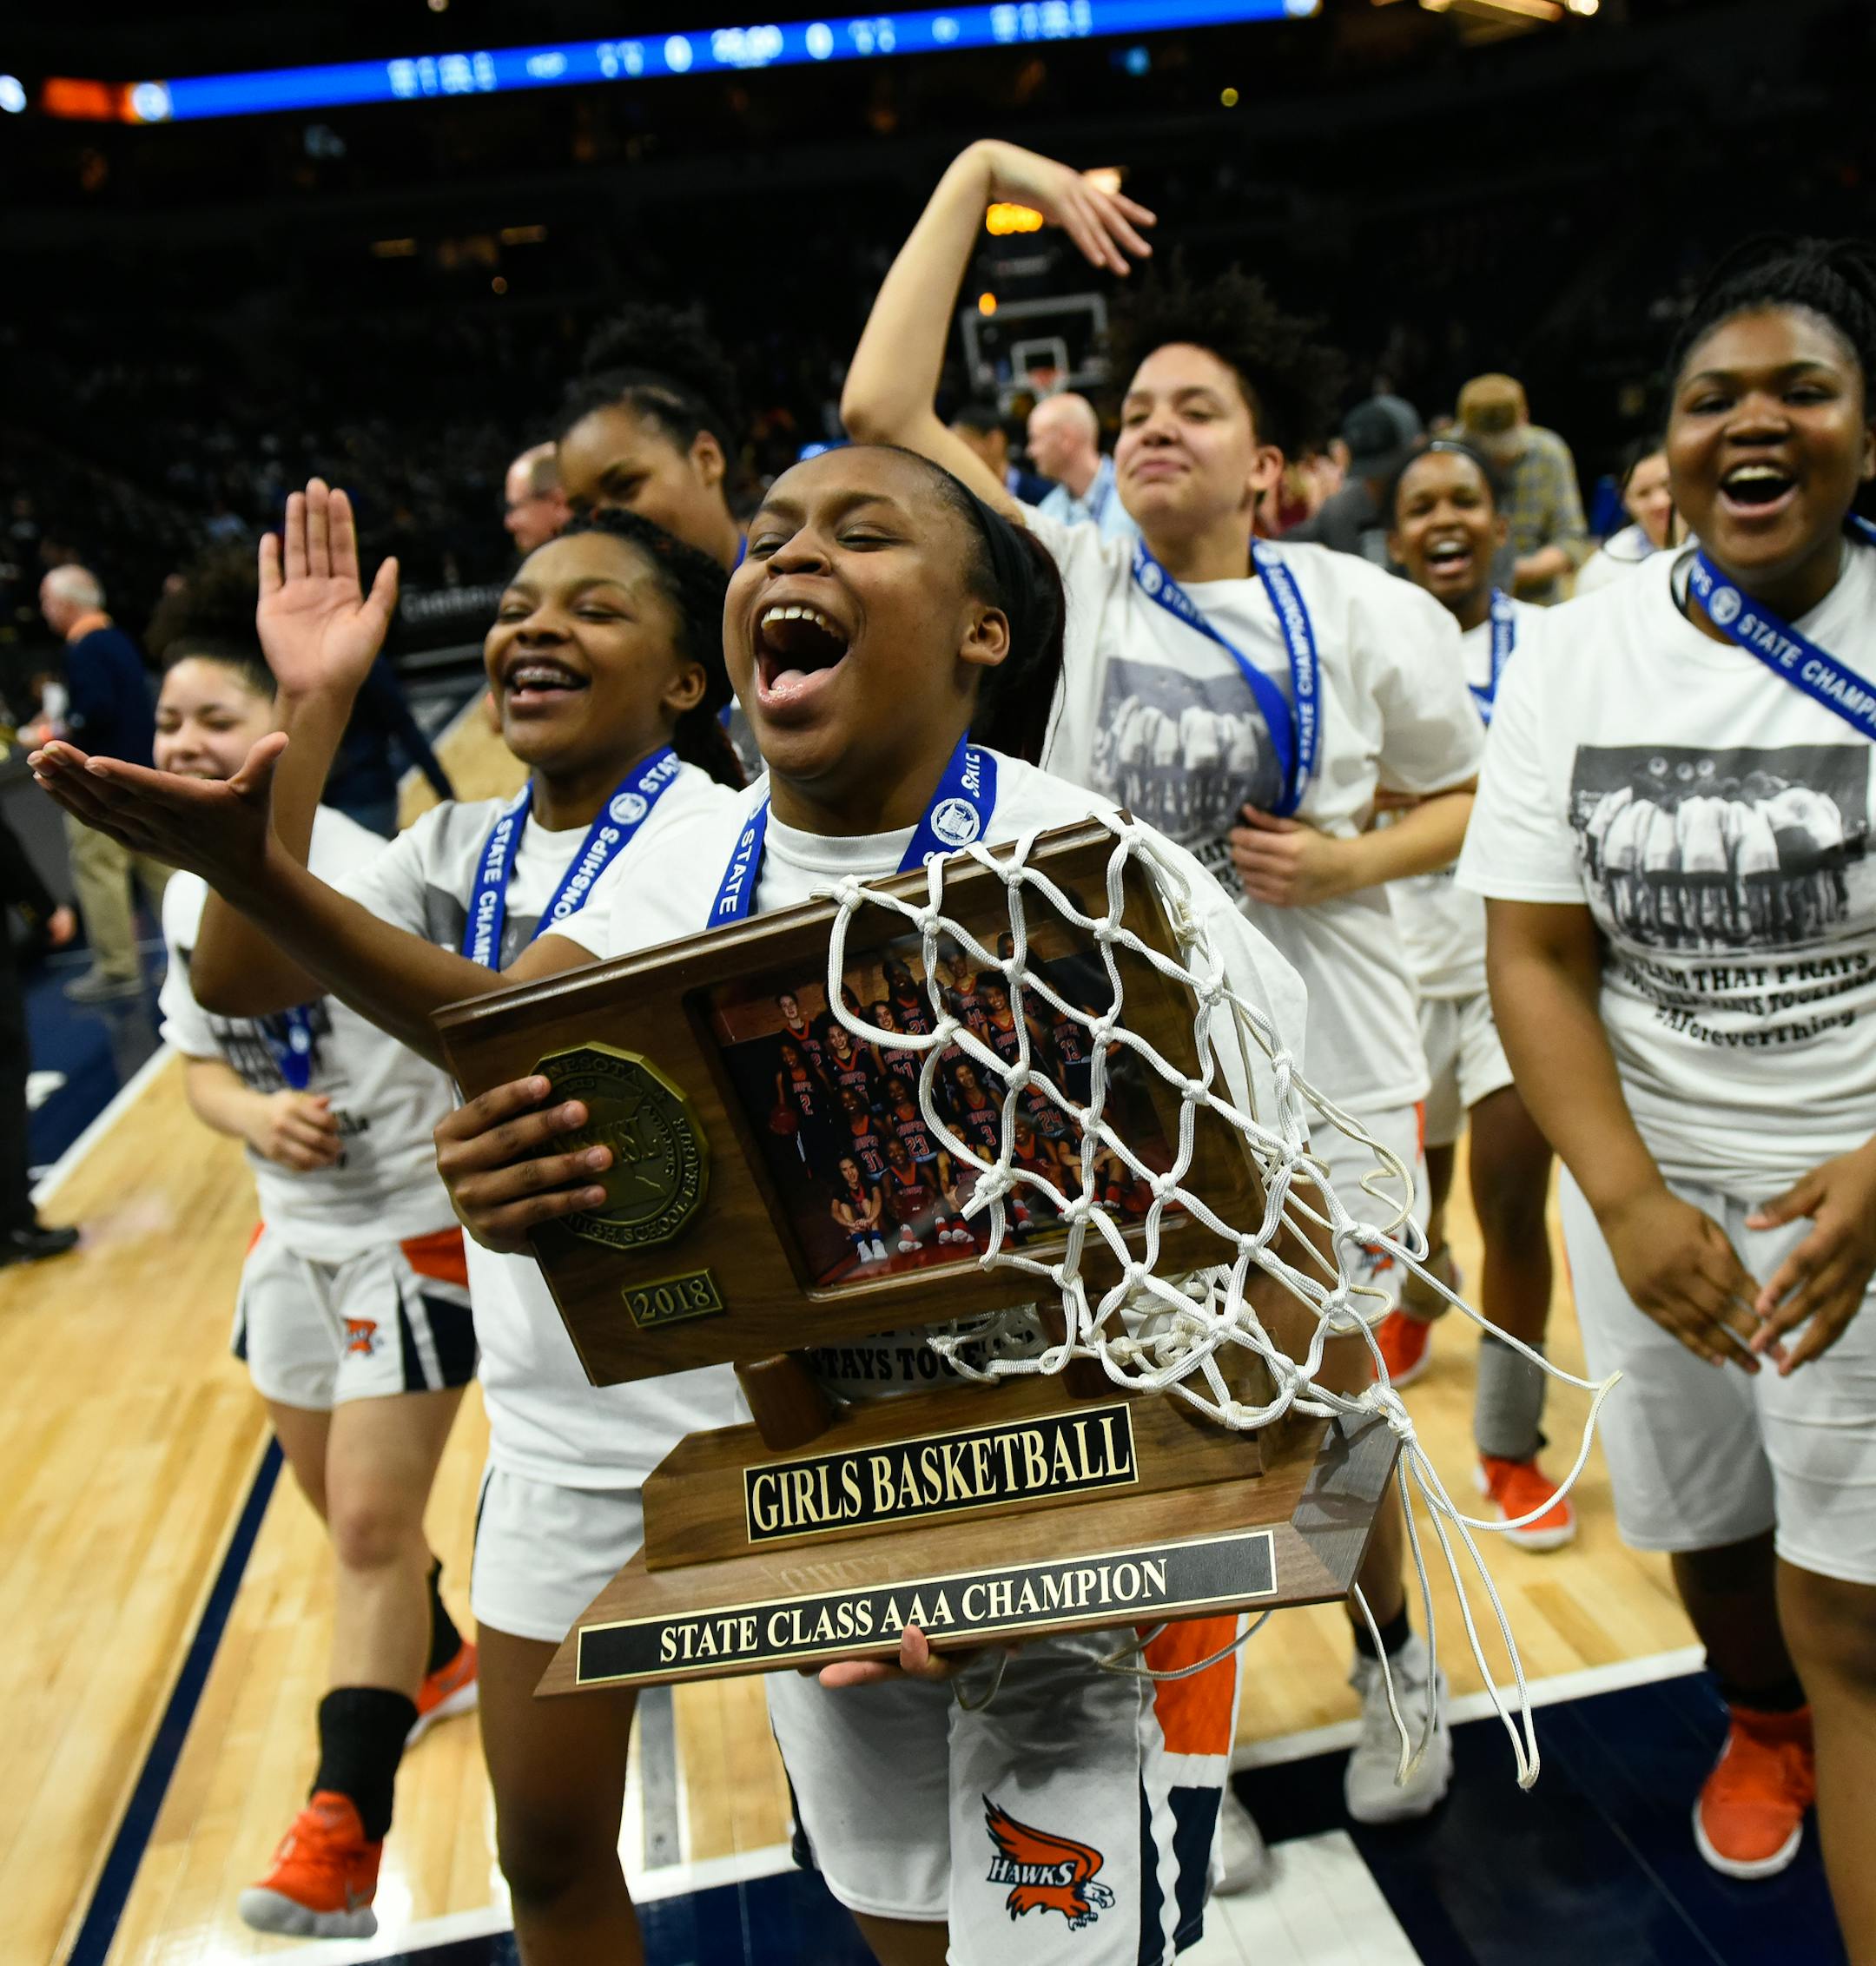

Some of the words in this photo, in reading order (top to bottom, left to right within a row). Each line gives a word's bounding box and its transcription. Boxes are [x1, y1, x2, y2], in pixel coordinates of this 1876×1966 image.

[1738, 613, 1803, 669] STATE
[483, 818, 513, 885] STATE
[718, 828, 755, 915] STATE
[1691, 966, 1767, 993] THAT
[1776, 950, 1869, 984] PRAYS
[549, 1054, 643, 1087] NESOTA
[904, 1134, 930, 1158] 23
[981, 1125, 997, 1147] 3
[861, 1148, 884, 1172] 31
[622, 1200, 688, 1243] SCHOOL
[632, 1278, 711, 1321] 2018
[809, 1347, 892, 1381] STAYS
[750, 1459, 862, 1532] GIRLS
[869, 1416, 1131, 1514] BASKETBALL
[659, 1615, 759, 1664] STATE
[767, 1600, 873, 1648] CLASS
[878, 1590, 955, 1633] AAA
[961, 1558, 1168, 1622] CHAMPION
[989, 1858, 1076, 1886] HAWKS
